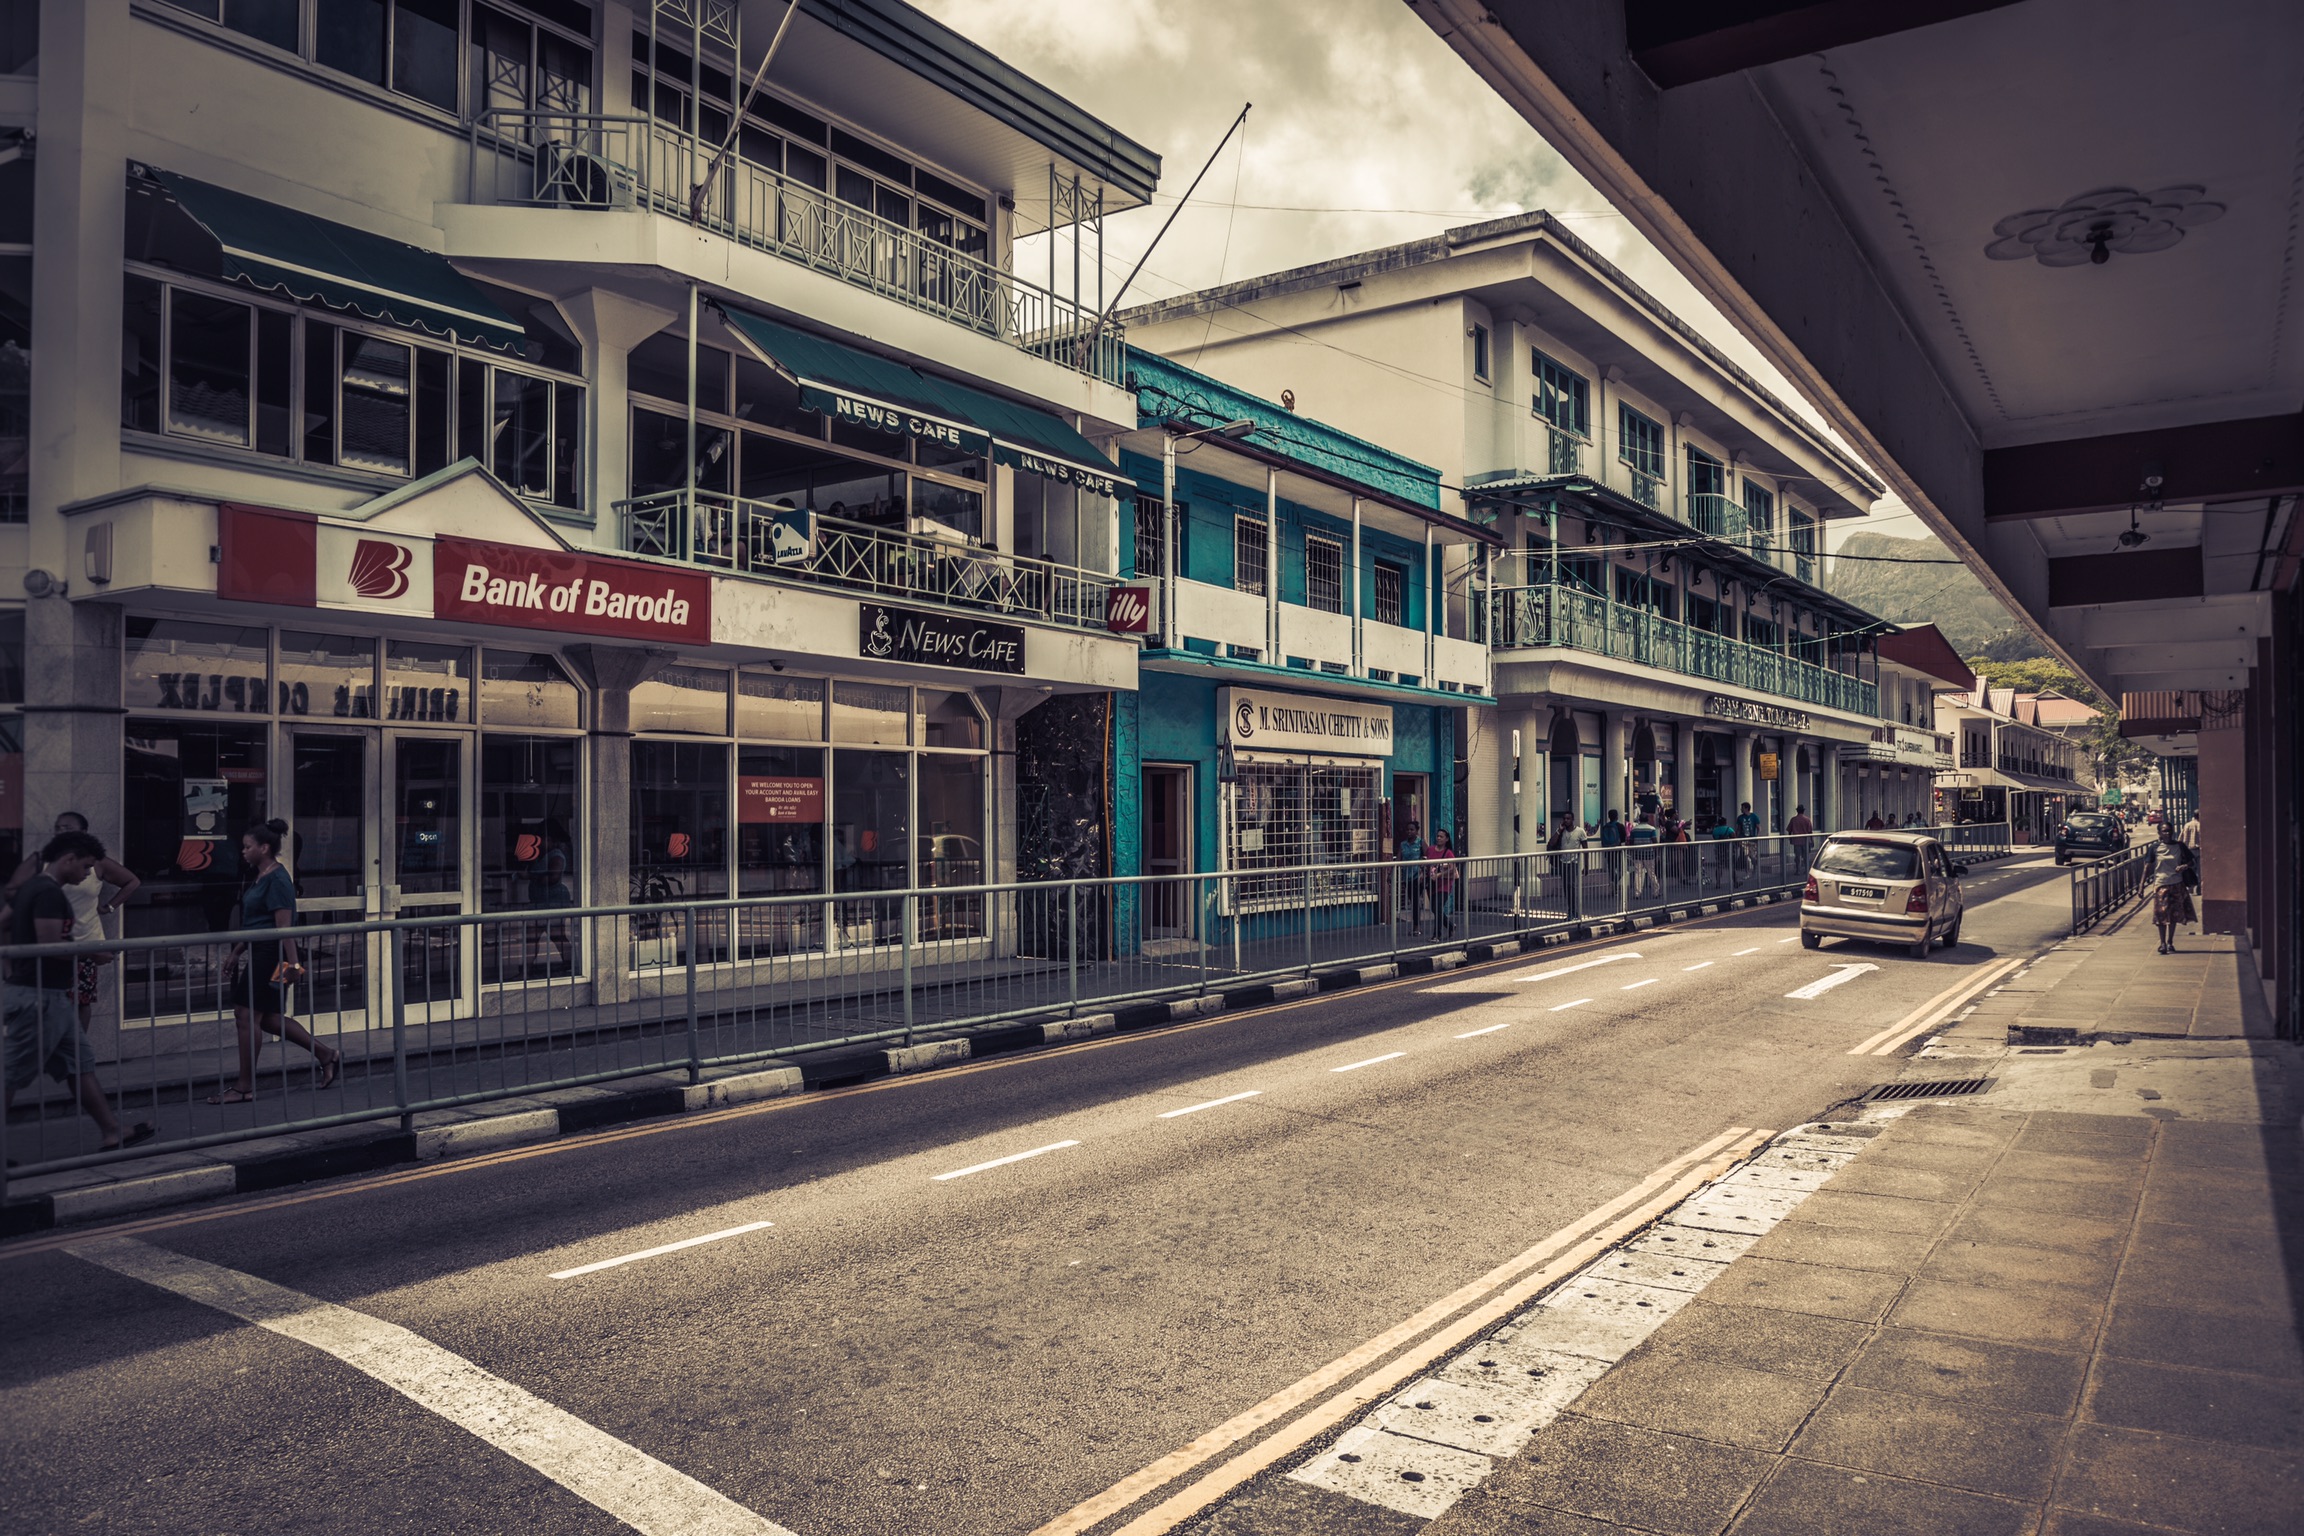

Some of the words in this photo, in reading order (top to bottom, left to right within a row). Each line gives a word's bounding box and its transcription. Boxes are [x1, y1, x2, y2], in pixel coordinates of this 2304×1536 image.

[836, 397, 899, 427] NEWS
[908, 418, 960, 444] CAFE
[1021, 454, 1068, 479] NEWS
[1075, 470, 1114, 493] CAFE
[460, 564, 547, 610] Bank
[549, 578, 584, 613] of
[585, 580, 690, 625] Baroda
[1109, 592, 1147, 629] illy
[899, 619, 966, 656] NEWS
[968, 630, 1018, 662] CAFE
[1259, 706, 1270, 730] M.
[1272, 707, 1327, 736] SRINIVASAN
[1328, 713, 1362, 739] CHETTY
[1363, 717, 1369, 738] &
[1370, 717, 1389, 740] SONS
[419, 833, 438, 842] Open
